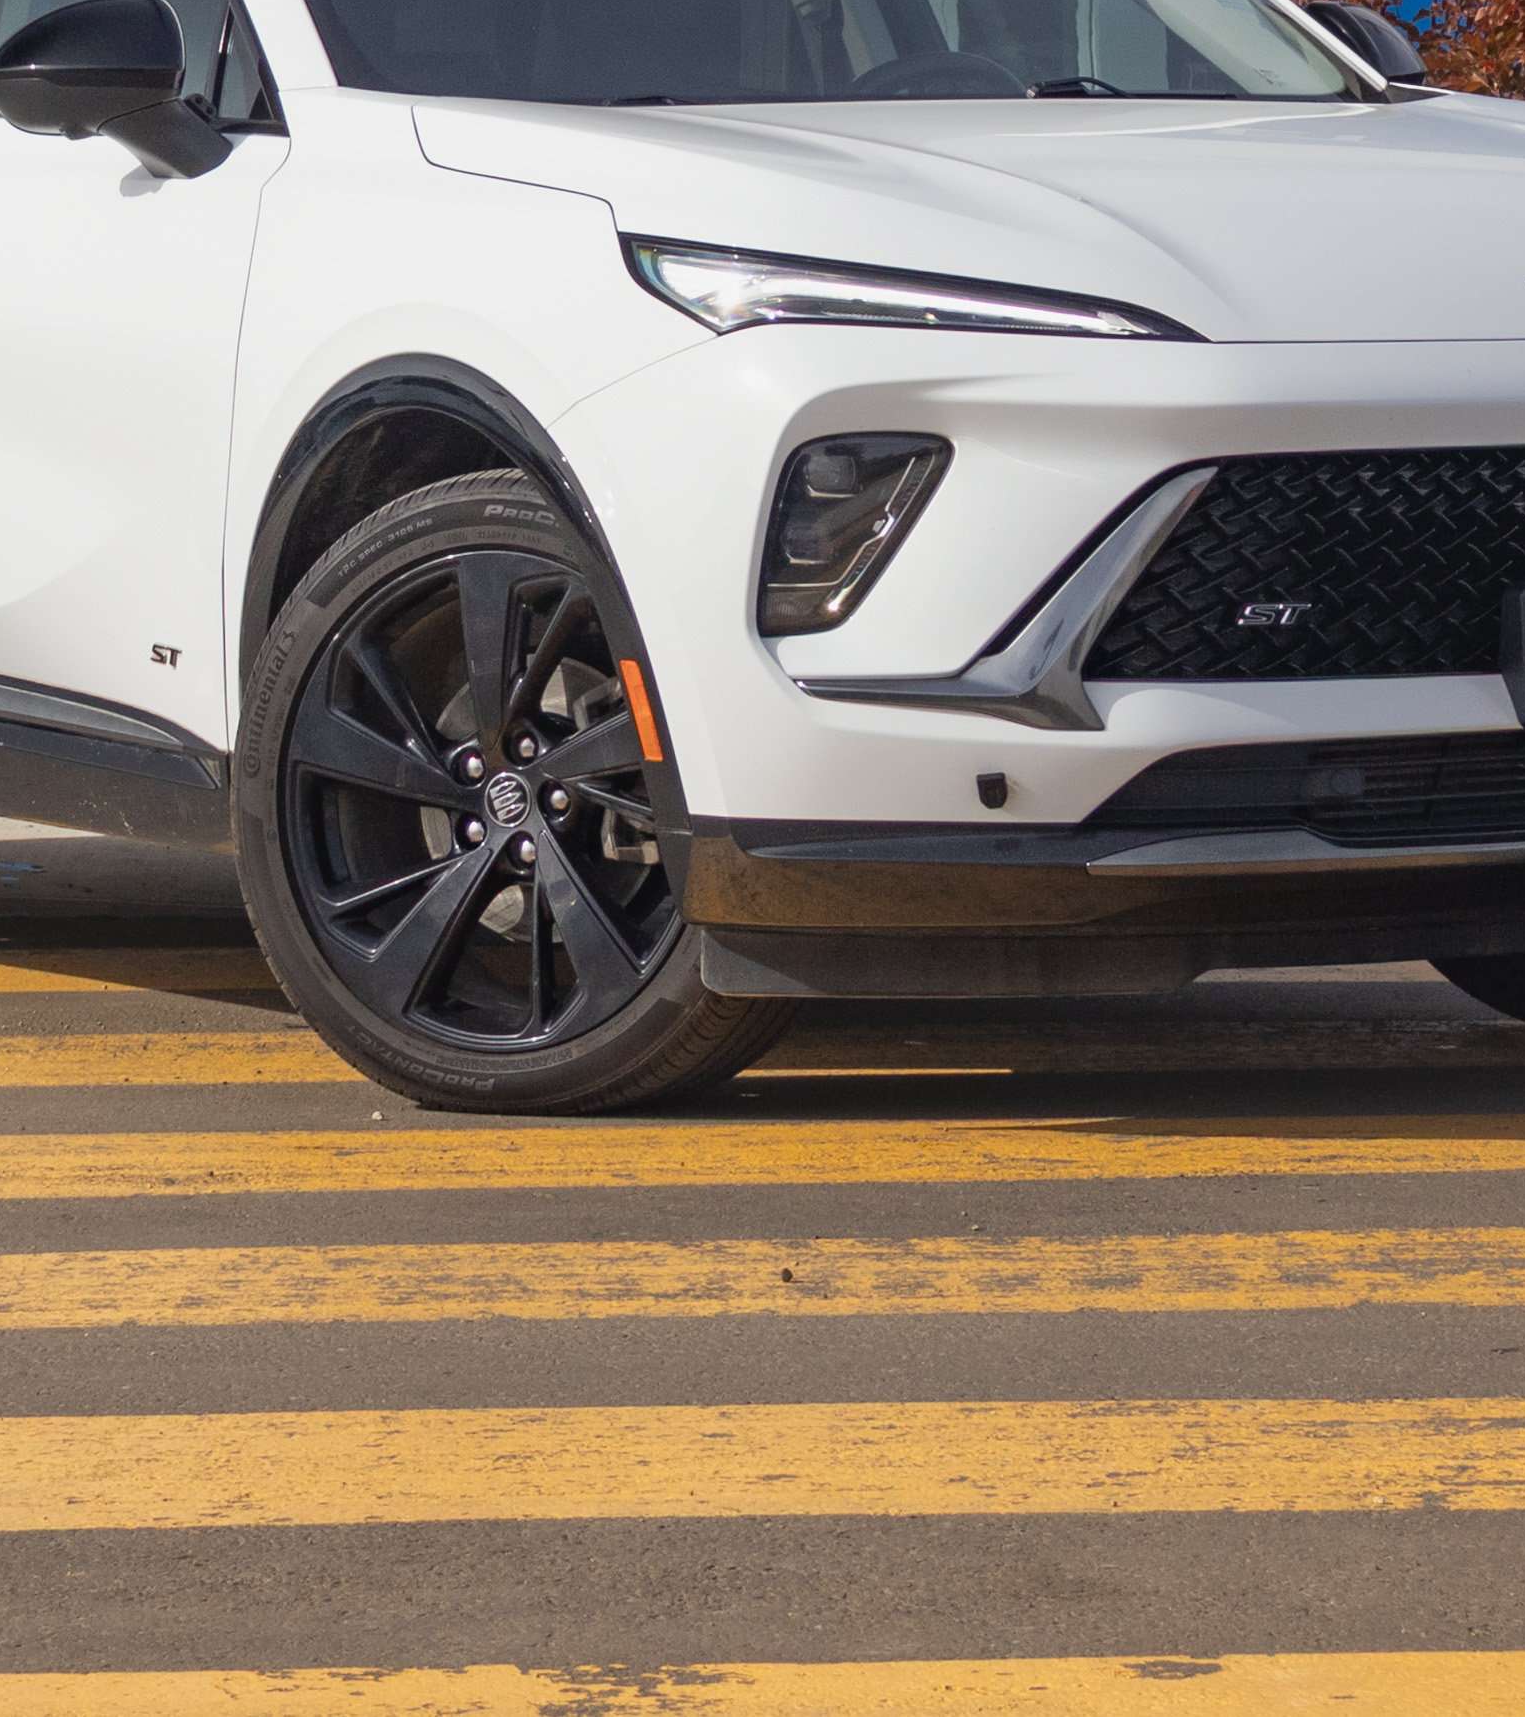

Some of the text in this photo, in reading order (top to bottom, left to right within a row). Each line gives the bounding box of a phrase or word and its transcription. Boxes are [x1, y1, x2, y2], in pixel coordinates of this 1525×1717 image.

[1236, 602, 1313, 626] ST
[149, 643, 183, 670] ST
[242, 645, 289, 779] Continental
